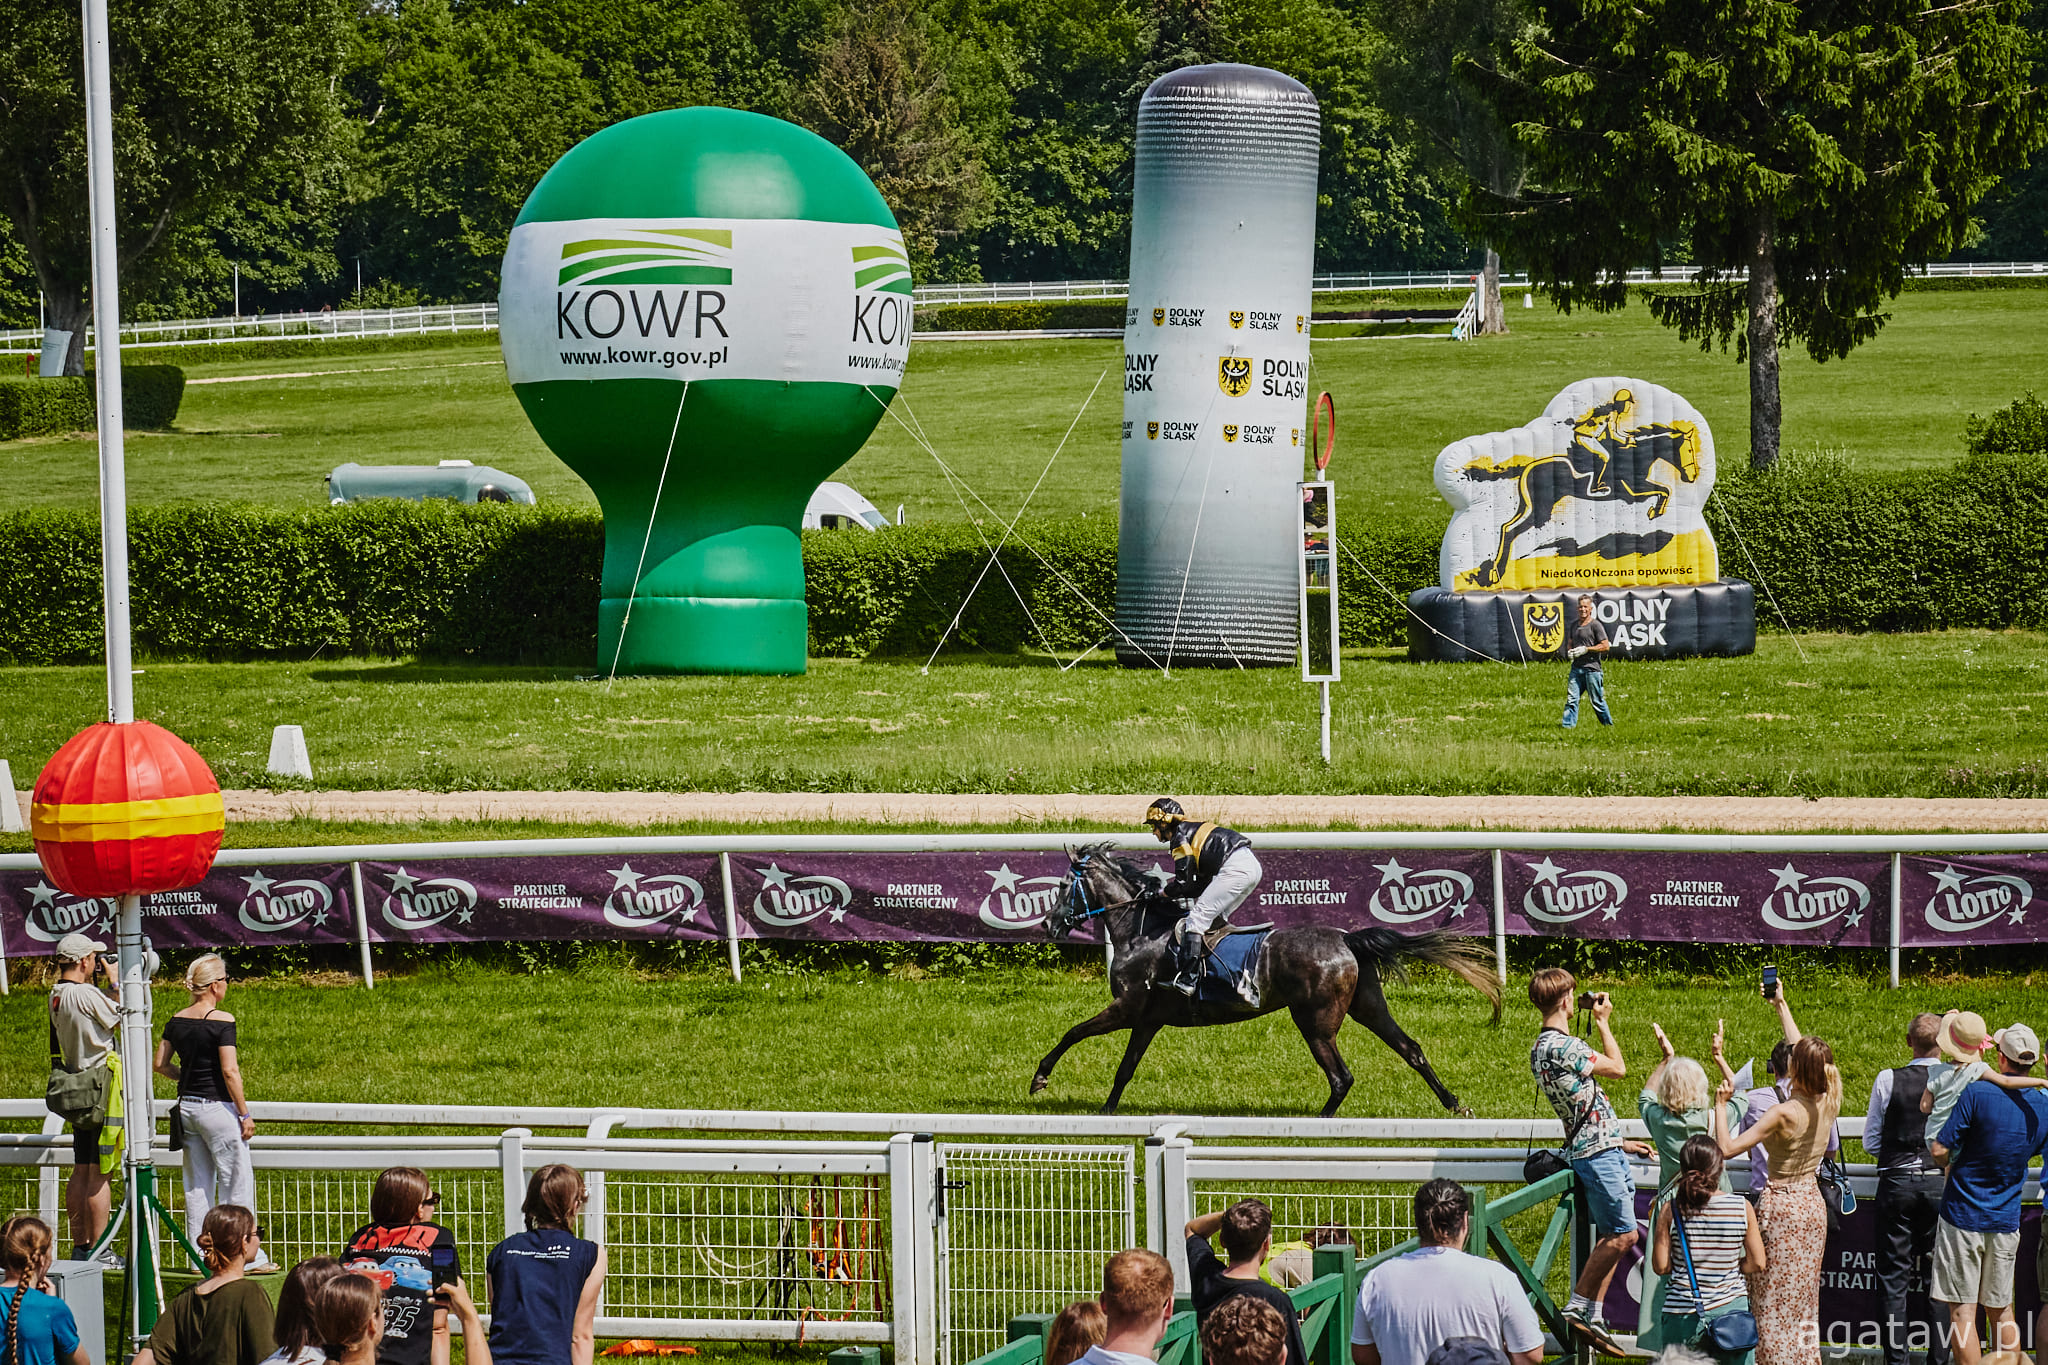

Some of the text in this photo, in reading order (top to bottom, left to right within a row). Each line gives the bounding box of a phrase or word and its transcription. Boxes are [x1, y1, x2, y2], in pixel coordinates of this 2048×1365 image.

[557, 289, 729, 340] KOWR
[1169, 308, 1205, 318] DOLNY
[1250, 311, 1282, 322] DOLNY
[852, 295, 912, 348] KOW
[1169, 317, 1203, 328] ŚLĄSK
[1249, 320, 1279, 331] ŚLĄSK
[559, 346, 729, 369] www.kowr.gov.pl
[1125, 354, 1159, 371] OLNY
[1263, 358, 1308, 379] DOLNY
[1124, 373, 1153, 394] LĄSK
[1262, 375, 1306, 401] ŚLĄSK
[1163, 422, 1199, 432] DOLNY
[1243, 425, 1276, 436] DOLNY
[1163, 431, 1196, 442] ŚLĄSK
[1243, 434, 1274, 445] ŚLĄSK
[1541, 566, 1693, 579] NiedoKONczona opowieść
[1609, 622, 1668, 651] ĄSK
[513, 884, 567, 897] PARTNER
[887, 883, 943, 896] PARTNER
[1274, 879, 1330, 892] PARTNER
[1666, 880, 1723, 894] PARTNER
[150, 891, 202, 904] PARTNER
[400, 887, 459, 919] LOTTO
[498, 896, 583, 910] STRATEGICZNY
[621, 884, 684, 917] LOTTO
[770, 885, 833, 917] LOTTO
[873, 895, 959, 909] STRATEGICZNY
[1259, 891, 1347, 906] STRATEGICZNY
[1389, 879, 1454, 912] LOTTO
[1541, 880, 1608, 913] LOTTO
[1649, 893, 1740, 908] STRATEGICZNY
[1945, 885, 2012, 920] LOTTO
[140, 903, 218, 917] STRATEGICZNY
[255, 890, 315, 921] LOTTO
[1783, 888, 1849, 919] LOTTO
[41, 898, 100, 931] LOTTO
